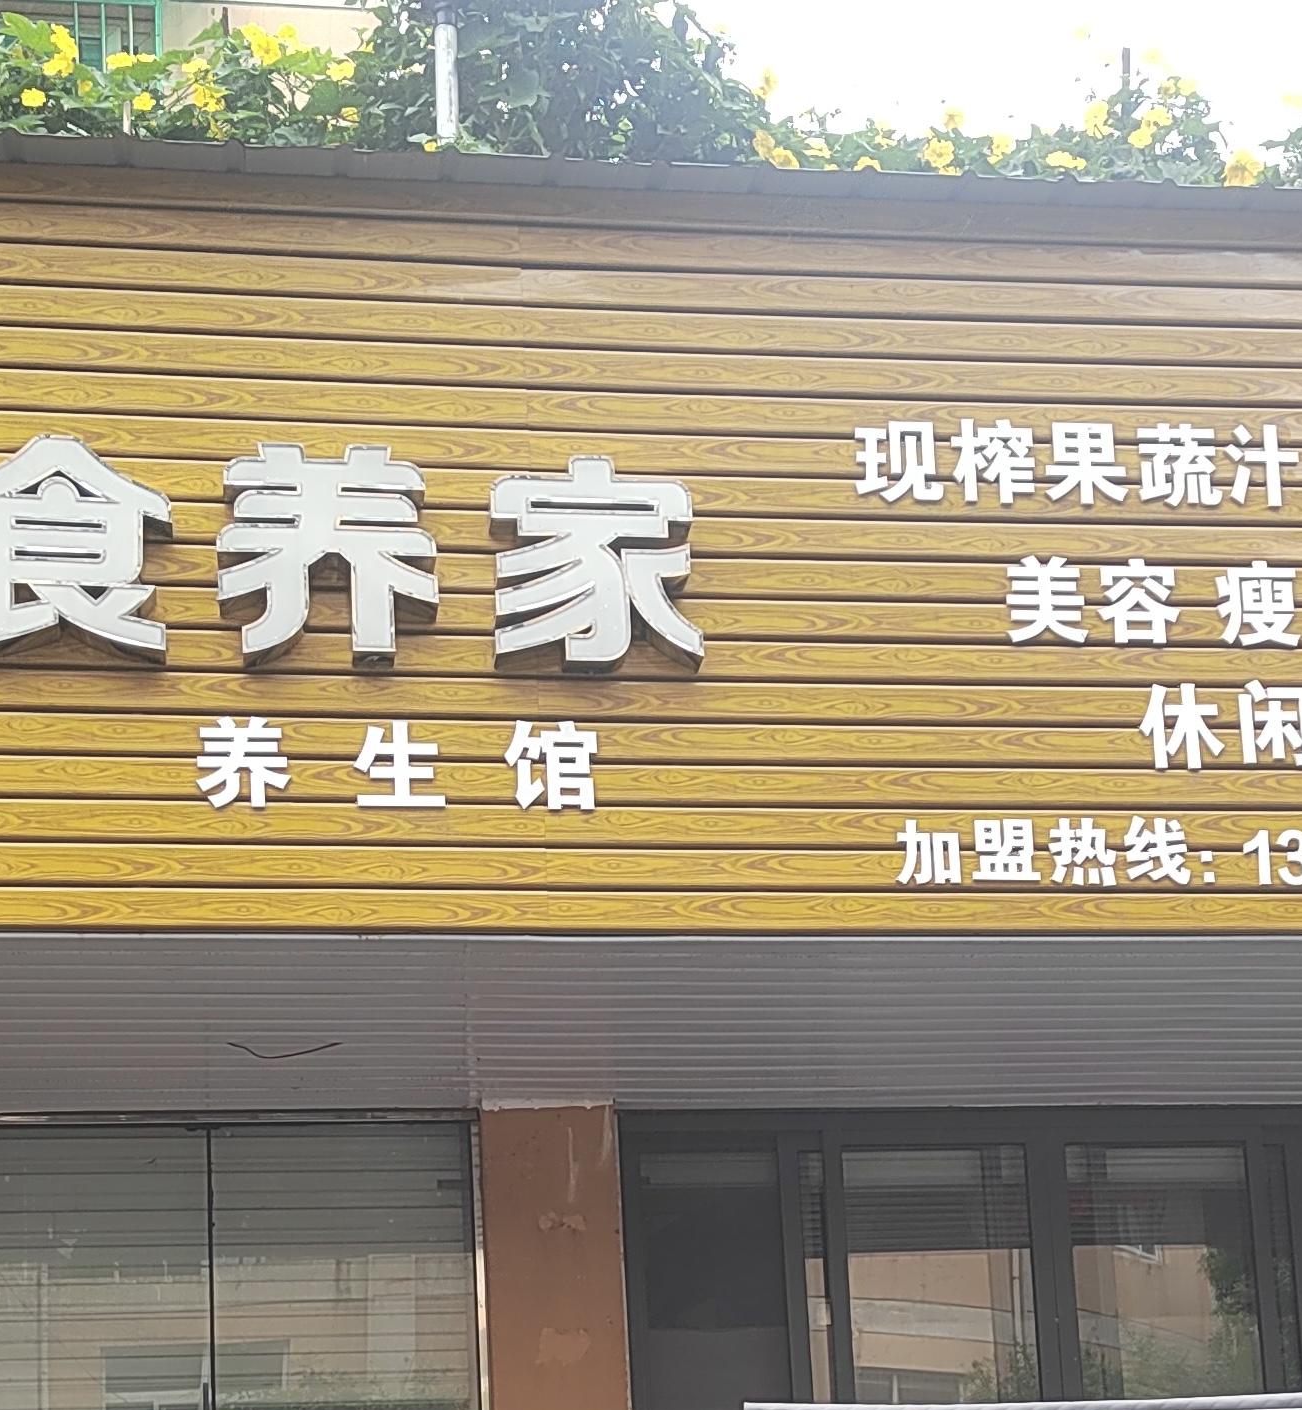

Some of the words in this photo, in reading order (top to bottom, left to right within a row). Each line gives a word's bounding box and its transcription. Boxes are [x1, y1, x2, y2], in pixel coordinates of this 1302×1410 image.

[854, 420, 1300, 508] 现榨果蔬汁
[1005, 556, 1182, 643] 美容
[196, 717, 598, 810] 养生馆
[894, 816, 1216, 887] 加盟热线:
